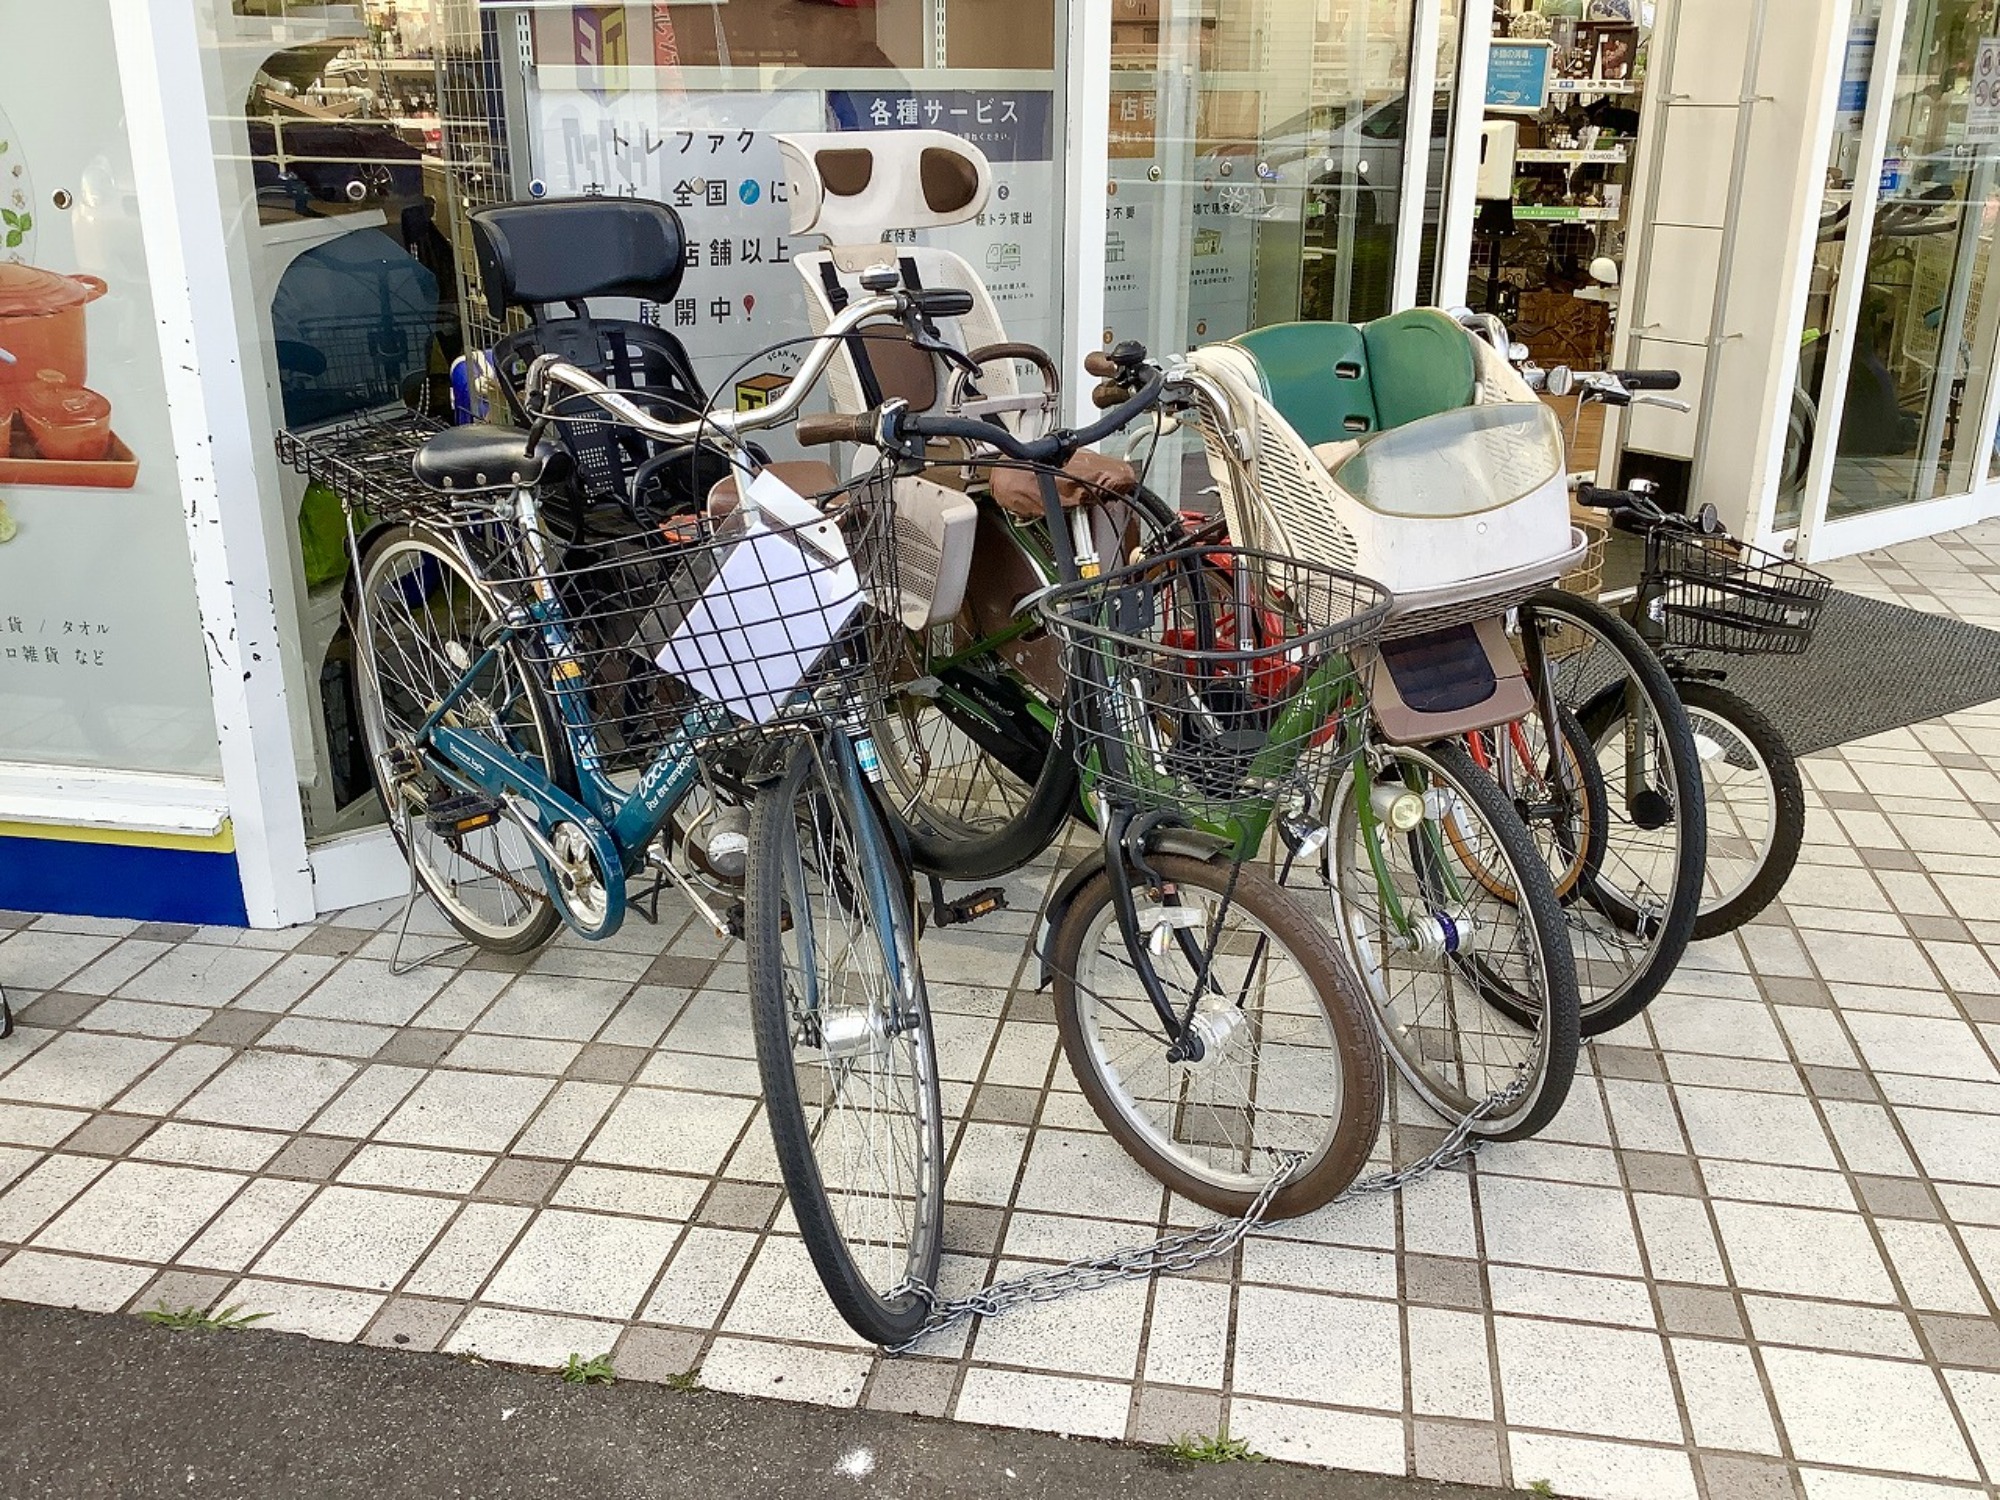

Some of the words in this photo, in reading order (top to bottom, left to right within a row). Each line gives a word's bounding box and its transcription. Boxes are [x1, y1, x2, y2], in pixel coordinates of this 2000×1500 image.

[870, 98, 1018, 126] 各種サービス
[613, 128, 753, 155] トレファク
[686, 237, 790, 267] 店舗以上
[767, 350, 789, 361] SCAN
[62, 620, 110, 635] タオル
[75, 648, 104, 666] など
[1627, 712, 1638, 752] Jeep
